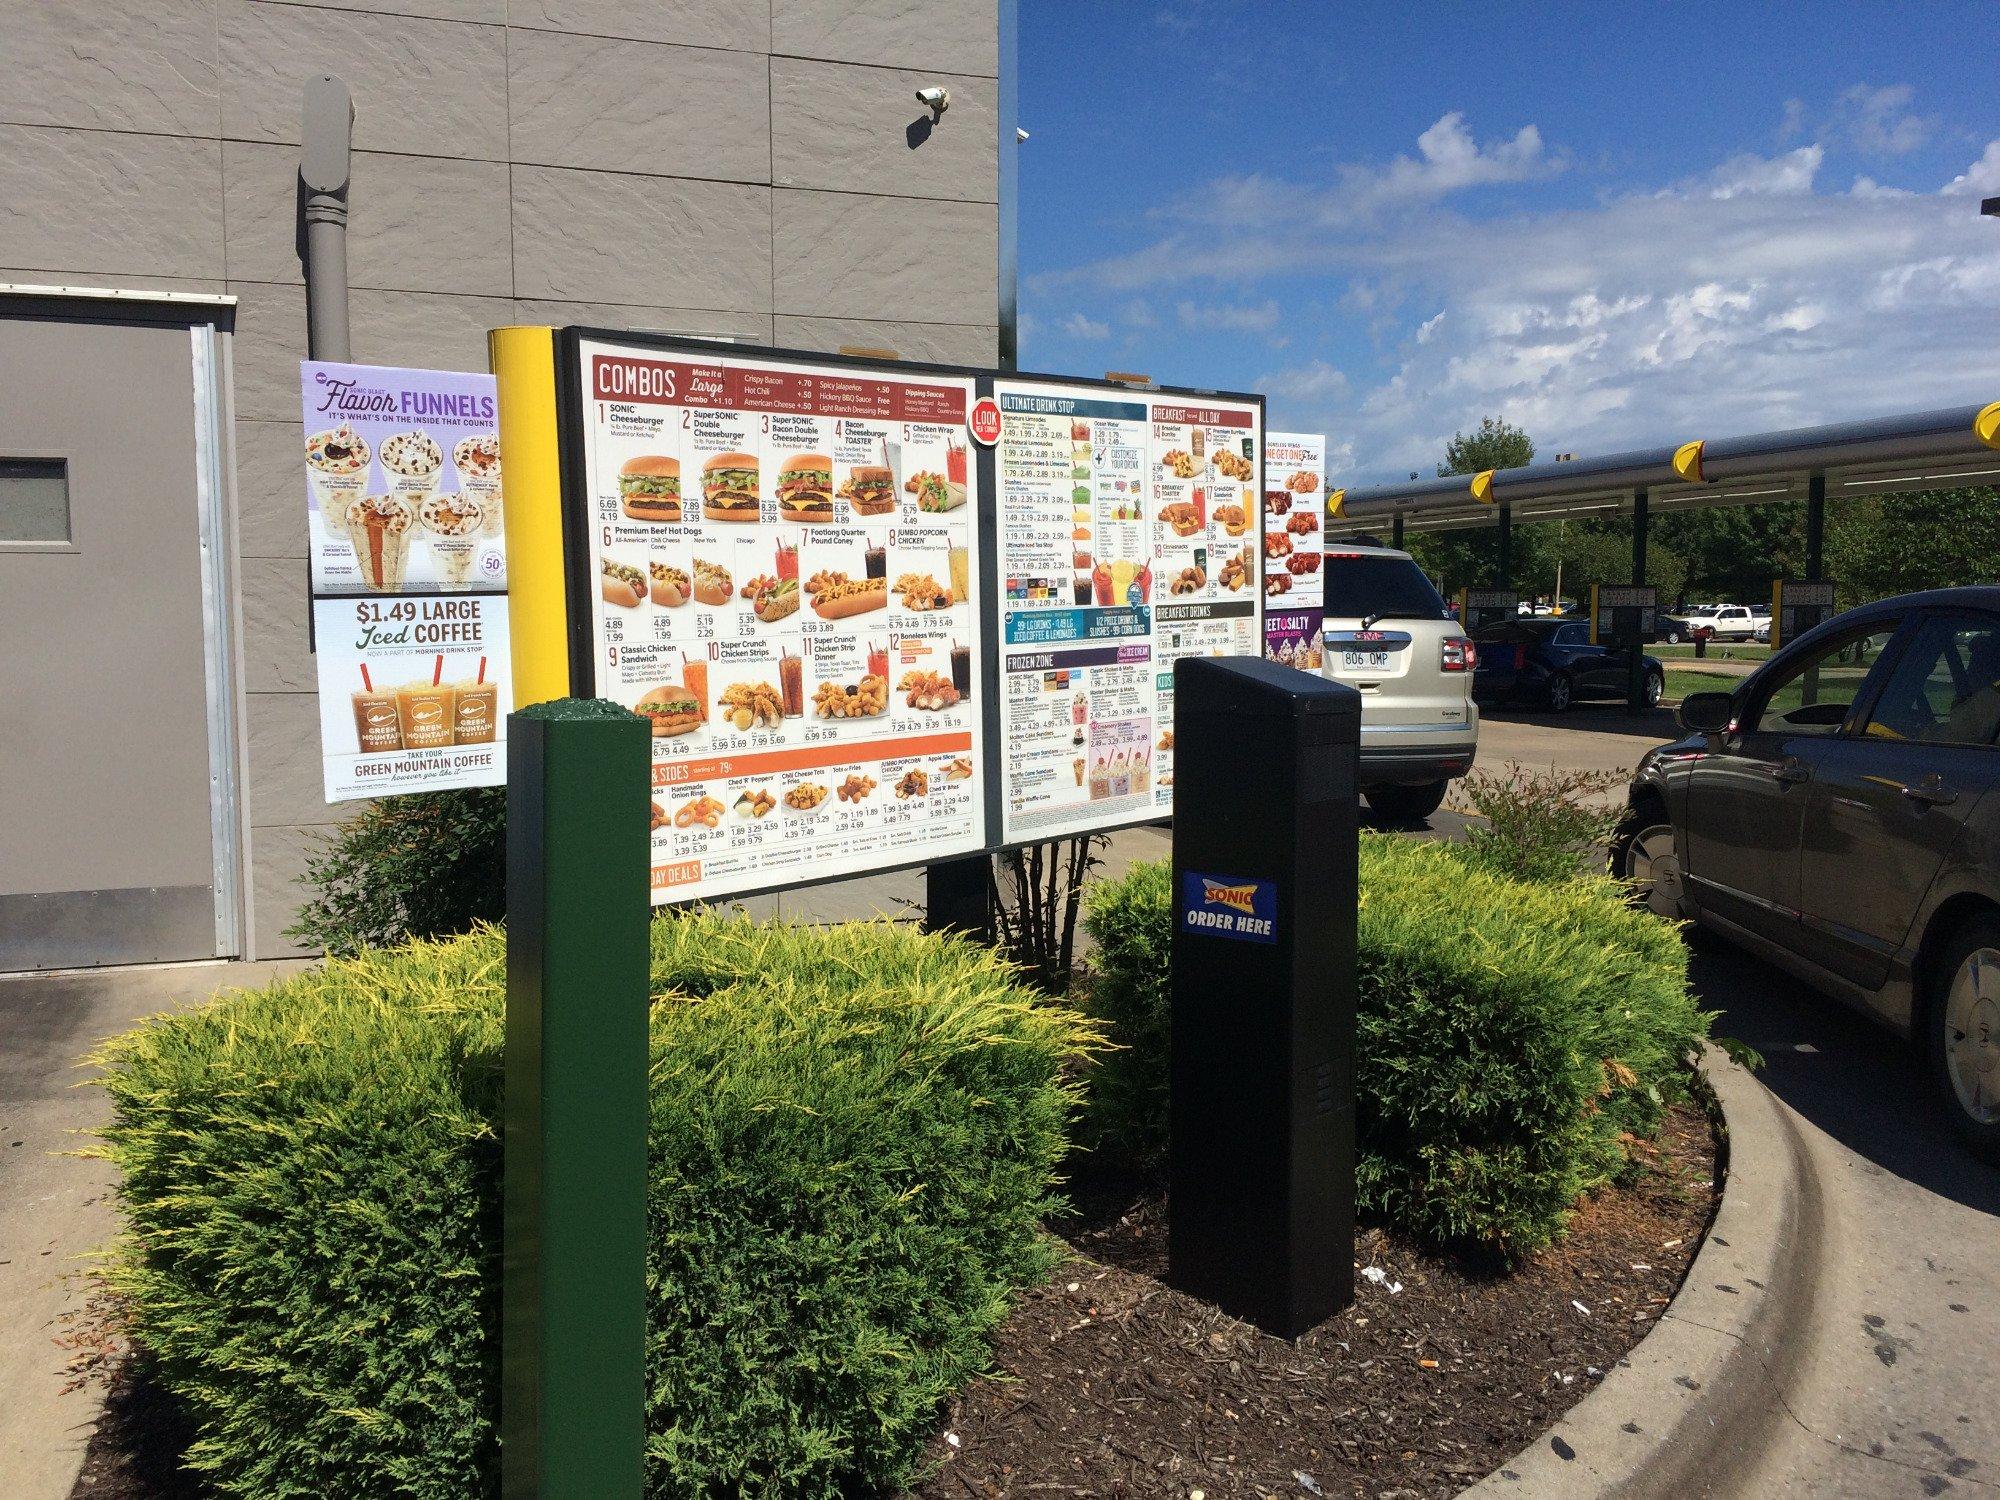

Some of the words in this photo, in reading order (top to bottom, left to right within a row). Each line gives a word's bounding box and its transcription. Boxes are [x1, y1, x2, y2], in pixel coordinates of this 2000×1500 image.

[692, 369, 709, 377] Make
[600, 363, 676, 398] COMBOS
[744, 375, 763, 384] Crispy
[764, 377, 783, 385] Bacon
[820, 381, 834, 390] Spicy
[690, 378, 723, 397] Large
[317, 380, 398, 413] Flavor
[401, 392, 493, 418] FUNNELS
[685, 395, 707, 403] Combo
[820, 393, 841, 402] Hickory
[905, 389, 925, 399] Dipping
[744, 399, 772, 407] American
[774, 401, 795, 409] Cheese
[820, 404, 833, 413] Light
[852, 407, 876, 415] Dressing
[1002, 397, 1034, 410] ULTIMATE
[1036, 400, 1058, 411] DRINK
[1058, 402, 1075, 413] STOP
[599, 403, 604, 423] 1
[610, 405, 635, 413] SONIC
[976, 412, 997, 425] LOOK
[1153, 408, 1185, 421] BREAKFAST
[1199, 411, 1210, 423] ALL
[1211, 412, 1220, 423] DAY
[329, 412, 345, 420] IT'S
[347, 413, 378, 422] WHAT'S
[463, 419, 494, 427] COUNTS
[610, 414, 664, 426] Cheeseburger
[683, 410, 690, 429] 2
[694, 420, 720, 428] Double
[762, 415, 769, 433] 3
[694, 429, 744, 440] Cheeseburger
[836, 420, 841, 438] 4
[845, 429, 887, 438] Cheeseburger
[904, 425, 910, 441] 5
[913, 425, 937, 433] Chicken
[938, 426, 954, 435] Wrap
[773, 435, 819, 443] Cheeseburger
[845, 437, 871, 445] TOASTER
[1276, 449, 1288, 459] GET
[1289, 450, 1302, 459] ONE
[1301, 450, 1318, 461] Free
[683, 502, 699, 510] 7.89
[600, 513, 617, 521] 4.19
[683, 514, 699, 522] 5.39
[604, 526, 611, 546] 6
[615, 527, 648, 535] Premium
[683, 528, 702, 536] Dogs
[802, 529, 808, 546] 7
[811, 529, 839, 537] Footlong
[835, 538, 853, 546] Coney
[890, 529, 896, 546] 8
[898, 529, 918, 537] JUMBO
[486, 558, 500, 570] 50
[357, 602, 416, 624] $1.49
[423, 601, 480, 620] LARGE
[1157, 608, 1188, 620] BREAKFAST
[1189, 606, 1210, 618] DRINKS
[1287, 617, 1309, 629] SALTY
[356, 625, 410, 649] Iced
[415, 623, 482, 643] COFFEE
[889, 633, 899, 650] 12
[707, 642, 719, 661] 10
[803, 638, 811, 656] 11
[841, 644, 855, 652] Strip
[609, 647, 617, 666] 9
[622, 655, 658, 663] Sandwich
[1008, 656, 1035, 669] FROZEN
[1036, 655, 1053, 666] ZONE
[1346, 653, 1363, 664] 806
[1370, 653, 1388, 665] OMP
[1158, 675, 1172, 687] KIDS
[407, 731, 449, 739] MOUNTAIN
[425, 750, 442, 758] YOUR
[355, 763, 391, 776] GREEN
[395, 757, 451, 773] MOUNTAIN
[454, 754, 492, 767] COFFEE
[391, 773, 422, 782] however
[660, 765, 688, 781] SIDES
[671, 784, 703, 792] Handmade
[691, 790, 706, 798] Rings
[669, 865, 699, 881] DEALS
[1206, 888, 1254, 905] SONIC
[1188, 910, 1233, 930] ORDER
[1236, 917, 1271, 935] HERE
